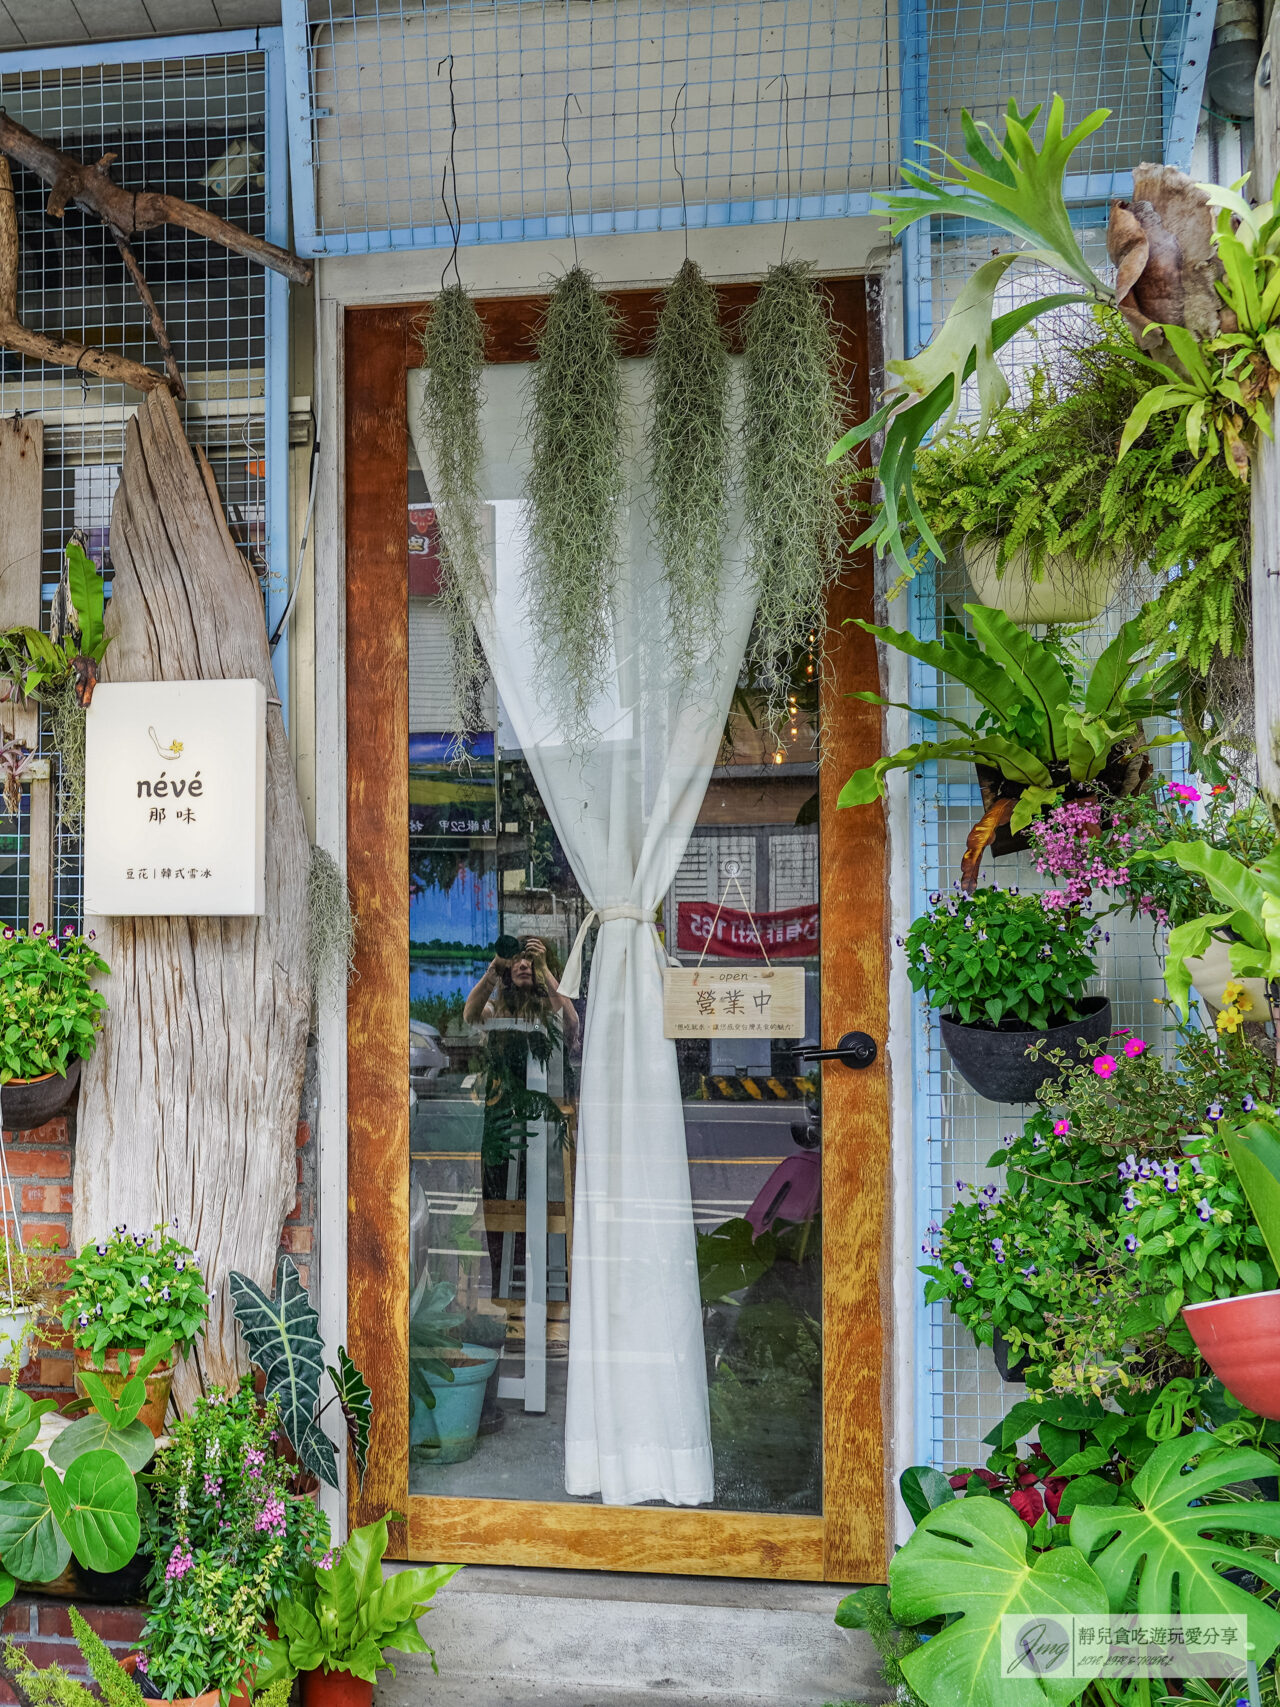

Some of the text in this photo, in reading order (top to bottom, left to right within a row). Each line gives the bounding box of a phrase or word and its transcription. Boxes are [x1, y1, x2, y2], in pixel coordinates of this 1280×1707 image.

[136, 771, 204, 799] névé
[148, 807, 197, 825] 那味
[719, 972, 749, 983] open
[696, 989, 772, 1015] 營業中
